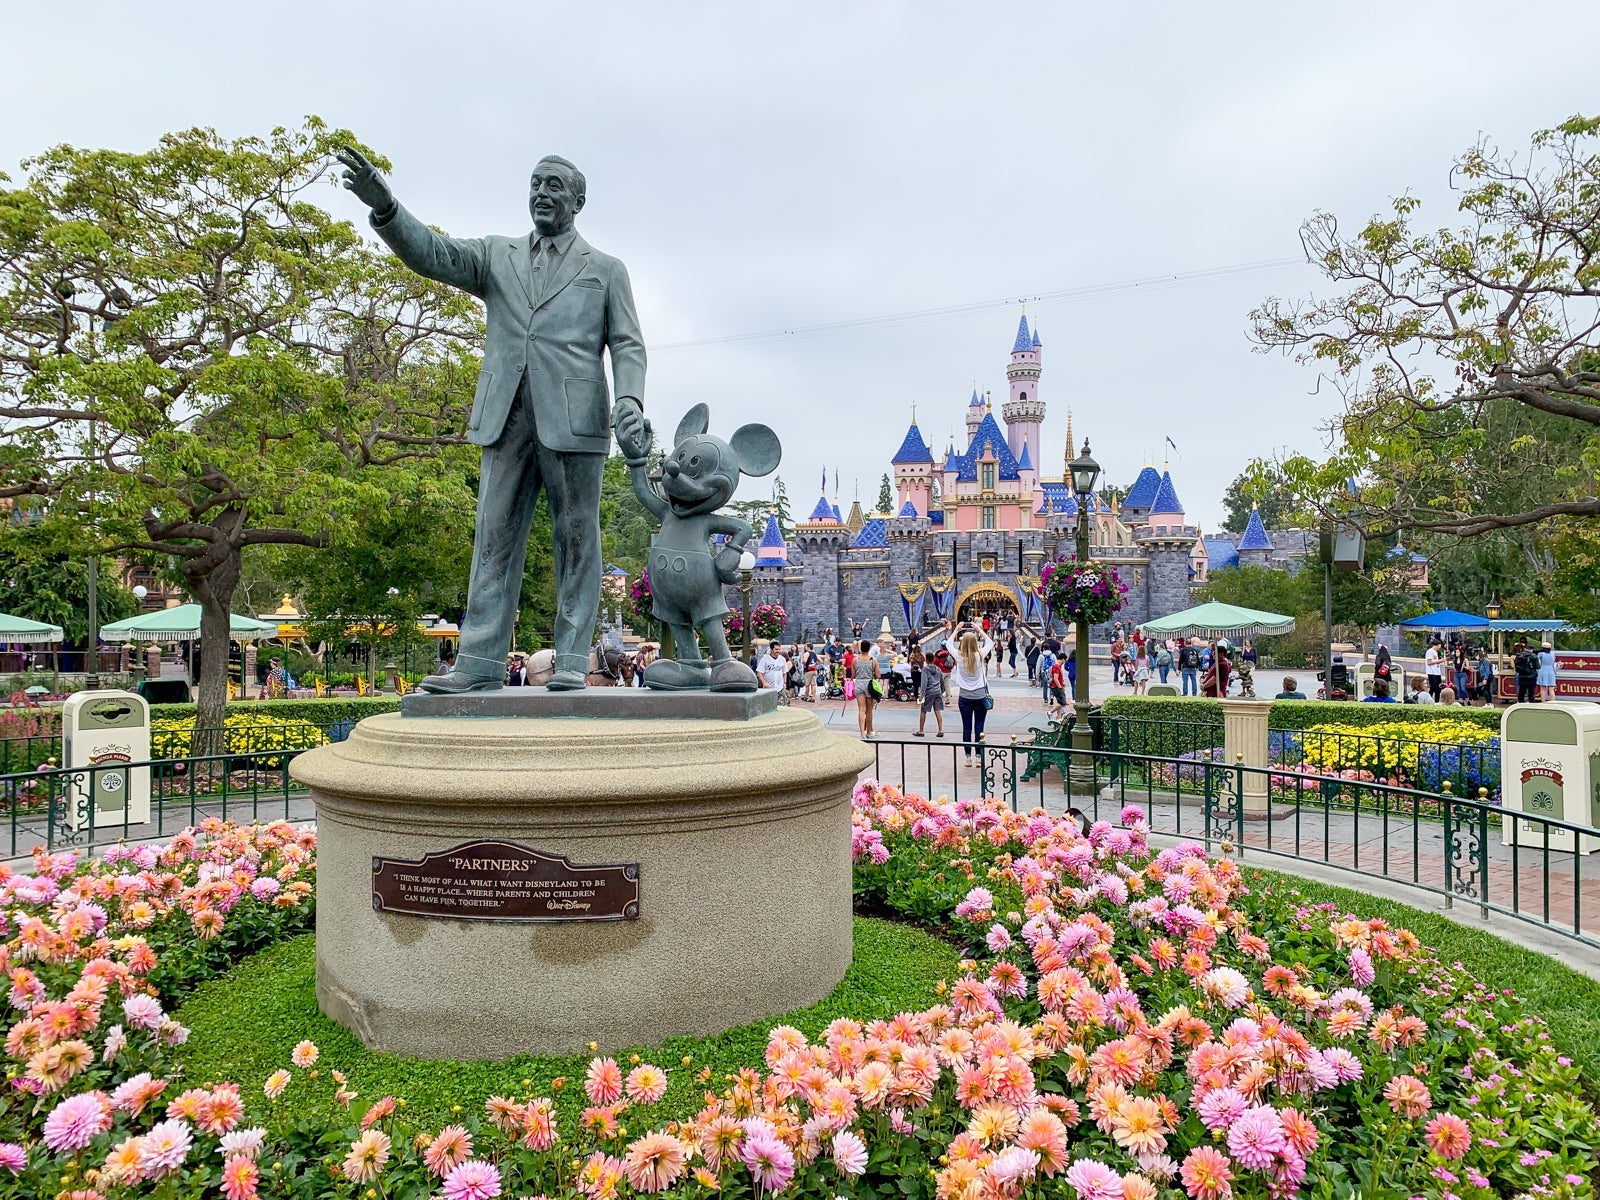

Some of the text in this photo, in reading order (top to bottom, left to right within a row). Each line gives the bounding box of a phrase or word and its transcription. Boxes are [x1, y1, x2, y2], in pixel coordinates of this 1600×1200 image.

[1560, 683, 1600, 694] Churros
[113, 754, 129, 762] PLEASE
[1529, 769, 1554, 777] TRASH
[400, 874, 420, 883] THINK
[421, 876, 440, 884] MOST
[469, 879, 493, 887] WHAT
[500, 880, 523, 888] WANT
[525, 880, 578, 888] DISNEYLAND
[594, 879, 606, 887] BE
[400, 883, 406, 891] IS
[413, 885, 436, 894] HAPPY
[495, 890, 531, 898] PARENTS
[532, 890, 551, 898] AND
[553, 889, 596, 898] CHILDREN
[404, 894, 418, 902] CAN
[420, 895, 438, 904] HAVE
[440, 897, 457, 906] FUN,
